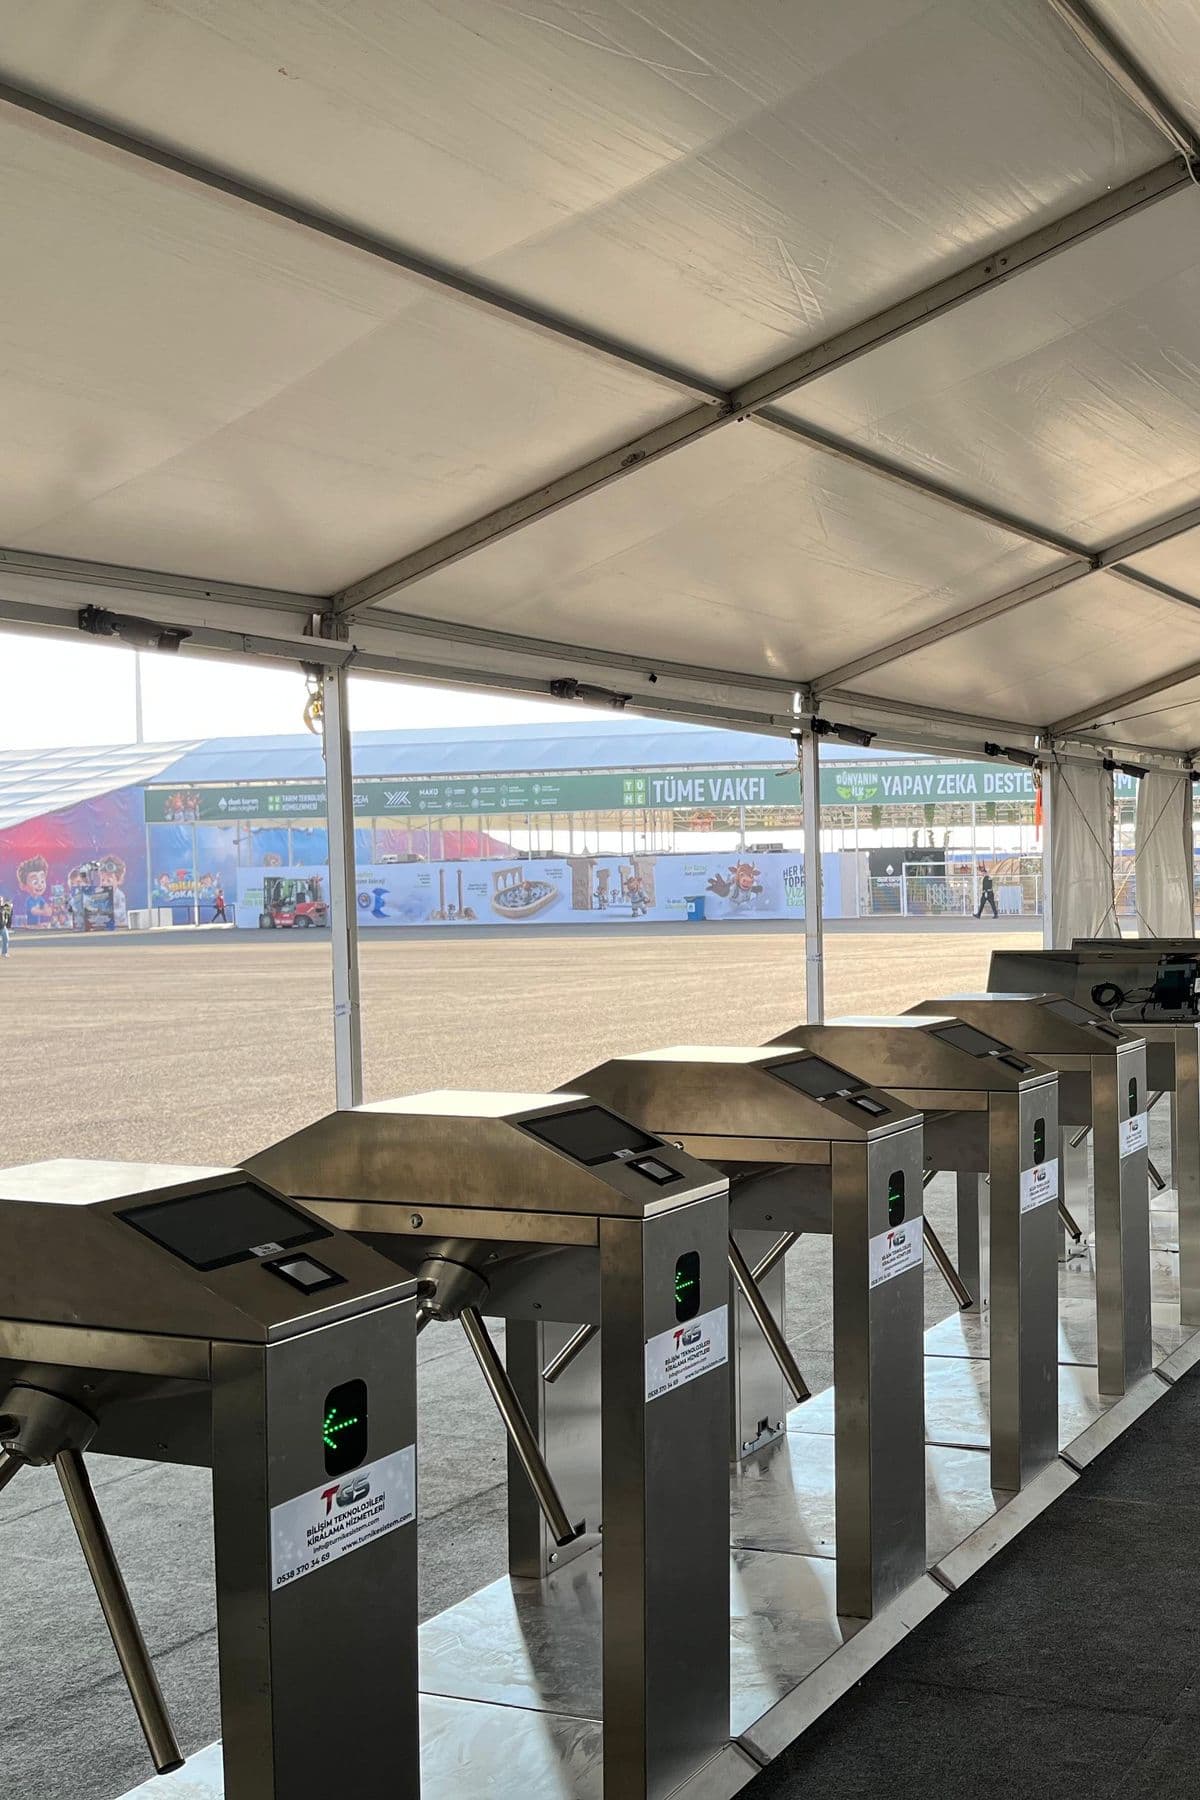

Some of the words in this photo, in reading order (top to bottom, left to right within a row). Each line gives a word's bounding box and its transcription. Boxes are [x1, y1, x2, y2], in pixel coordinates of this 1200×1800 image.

[652, 776, 705, 803] TÜME
[708, 777, 765, 801] VAKFI
[881, 774, 933, 796] YAPAY
[937, 773, 976, 795] ZEKA
[983, 771, 1034, 794] DESTE
[320, 1471, 371, 1516] TGS
[306, 1518, 332, 1538] BİLİŞİM
[334, 1491, 386, 1524] TEKNOLOJİLERİ
[307, 1524, 344, 1547] KİRALAMA
[345, 1502, 385, 1529] HİZMETLERİ
[276, 1569, 295, 1585] 0538
[296, 1562, 309, 1576] 370
[310, 1557, 321, 1569] 34
[321, 1552, 331, 1562] 69
